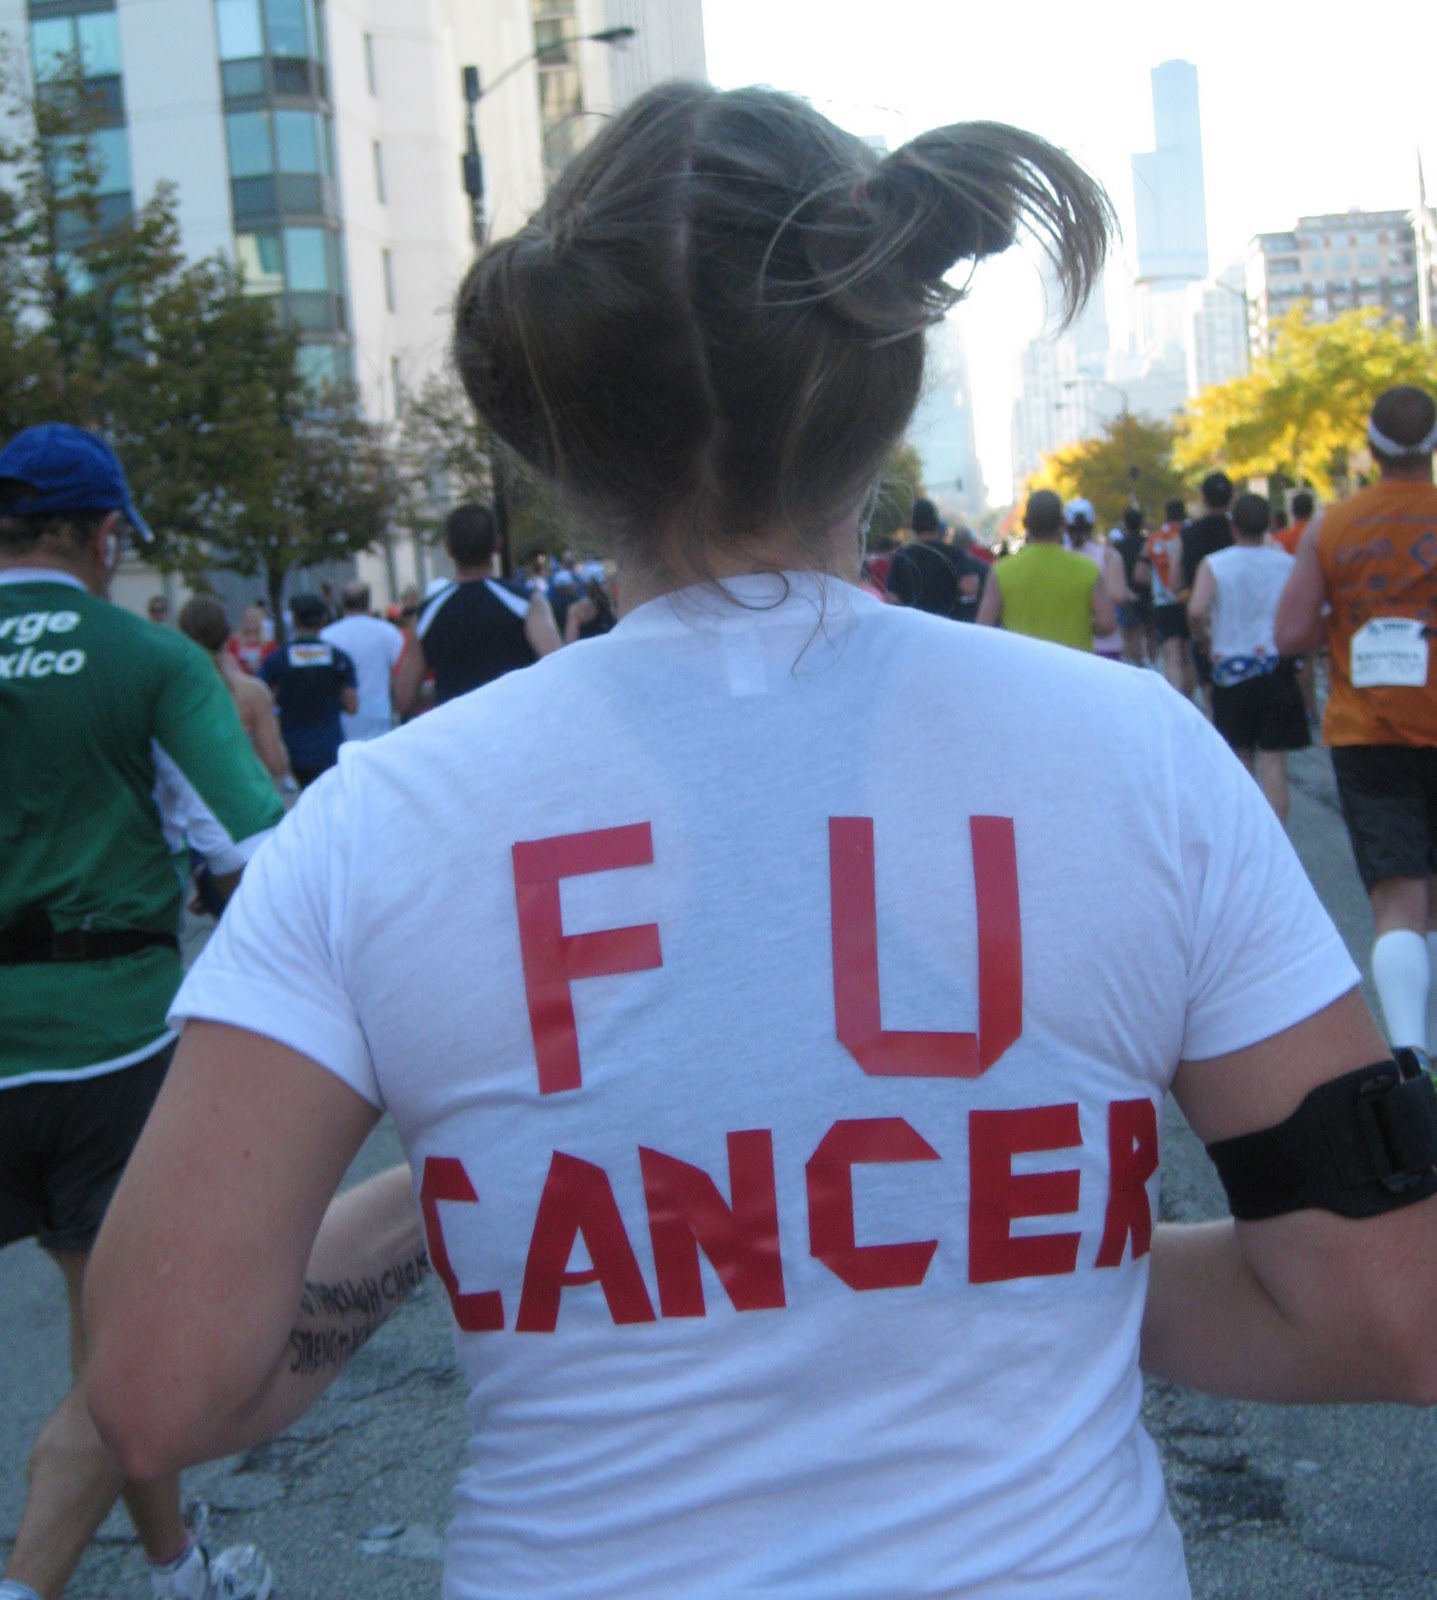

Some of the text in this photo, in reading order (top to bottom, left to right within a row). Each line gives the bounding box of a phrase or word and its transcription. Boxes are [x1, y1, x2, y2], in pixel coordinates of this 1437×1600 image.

[511, 815, 1023, 1095] F U
[420, 1098, 1159, 1333] CANCER
